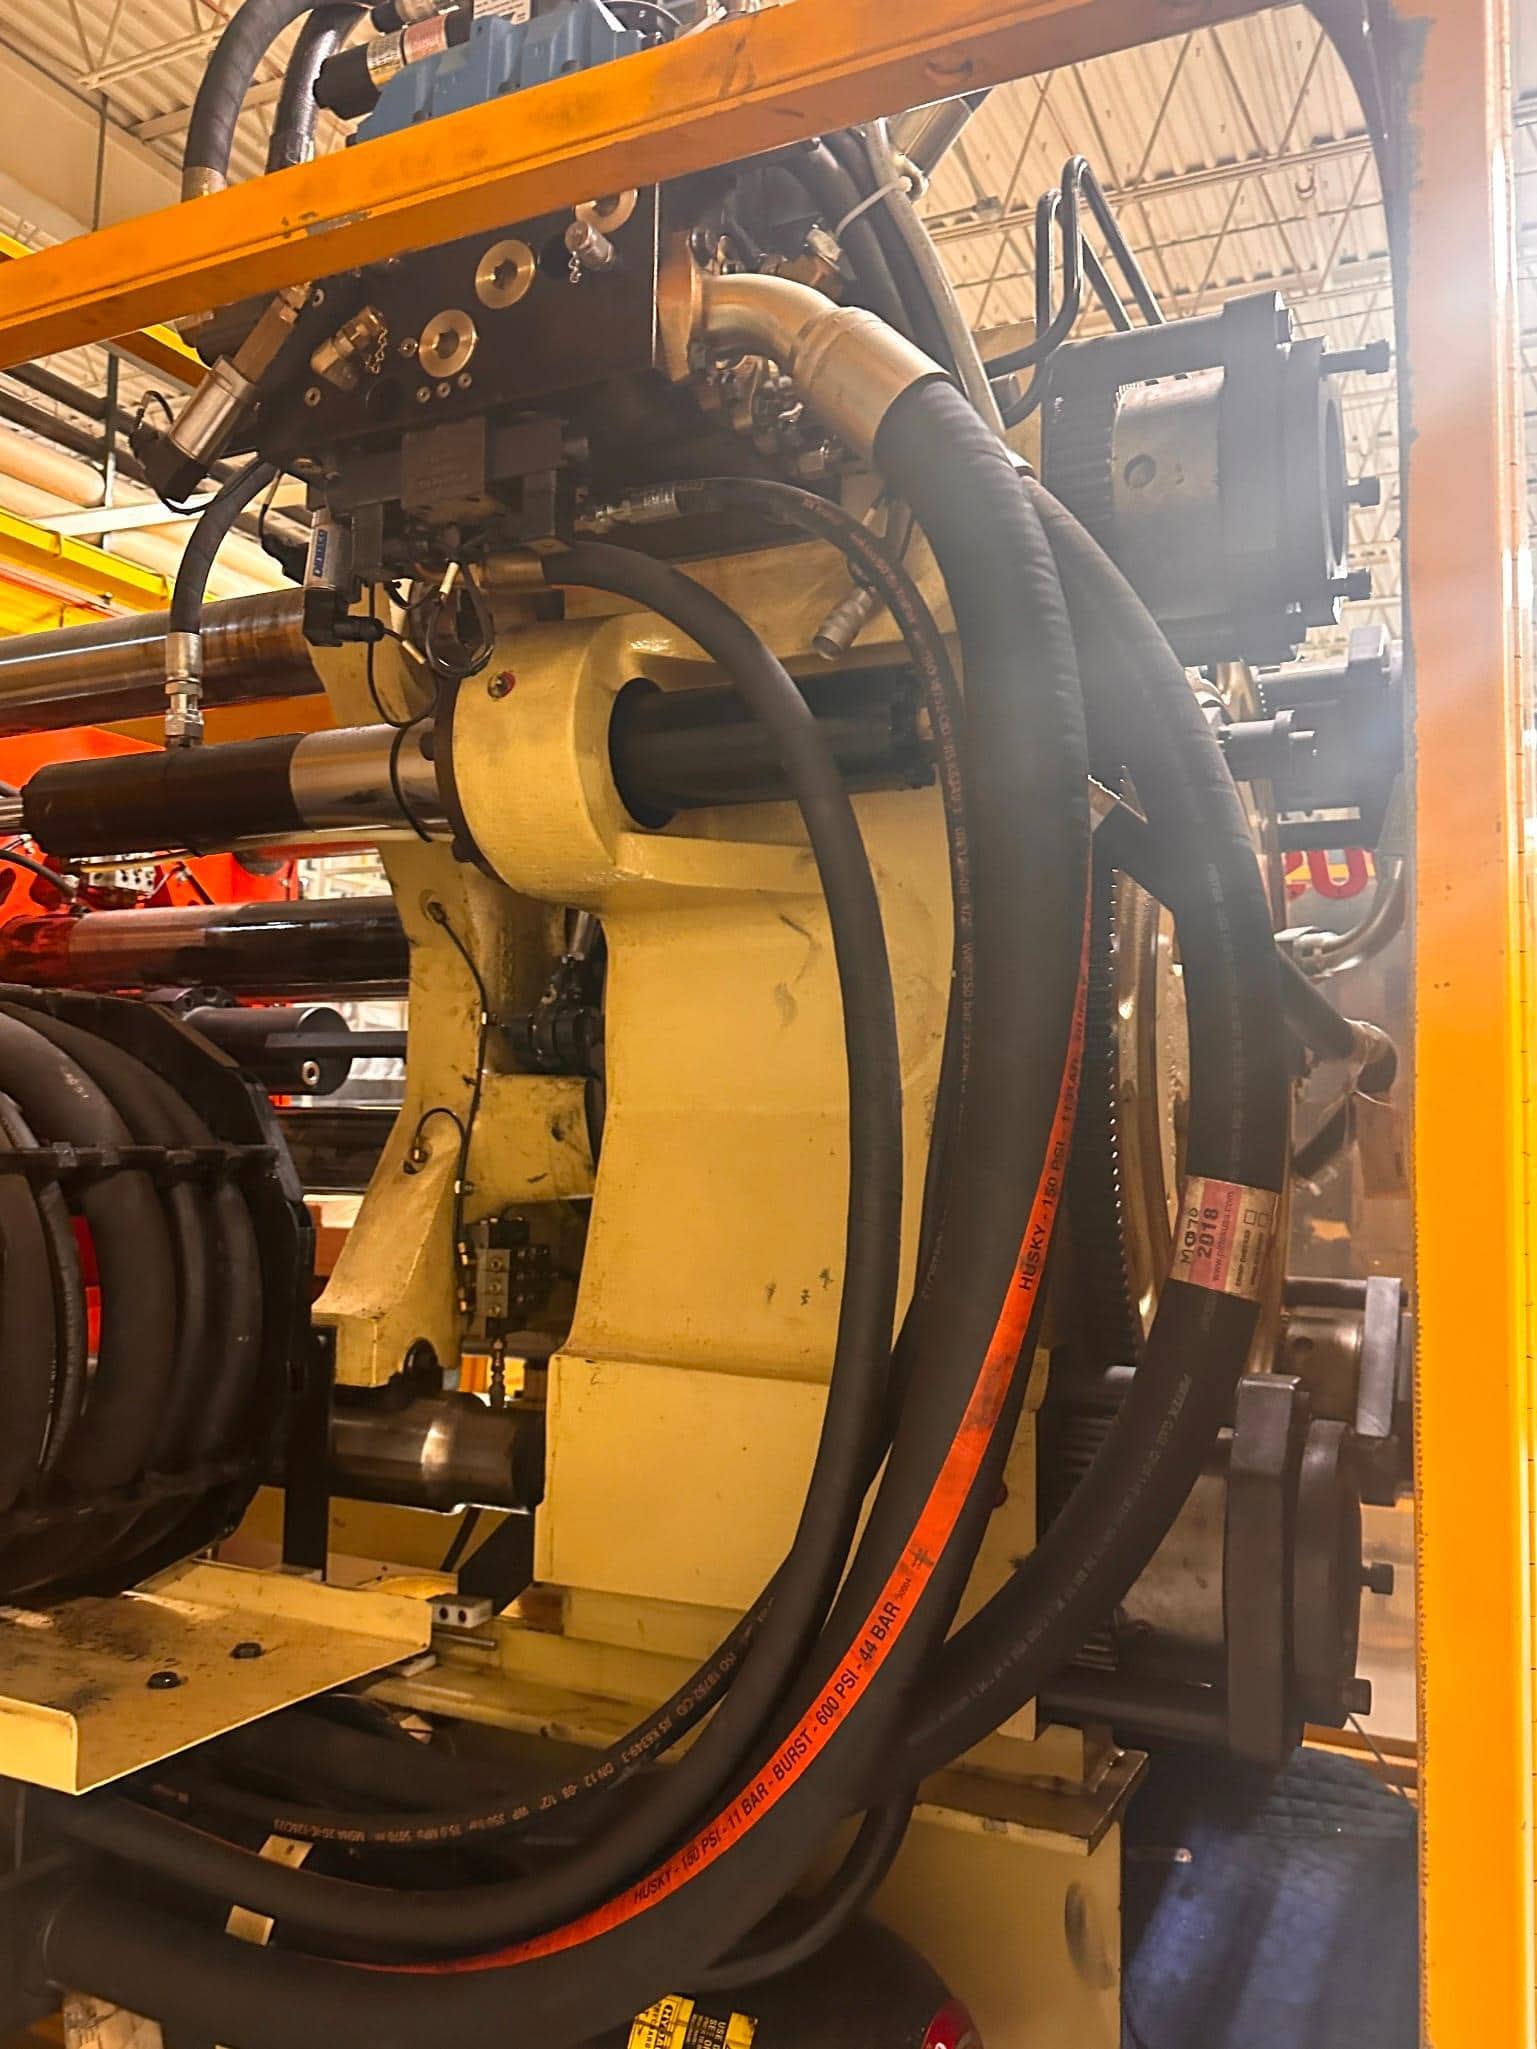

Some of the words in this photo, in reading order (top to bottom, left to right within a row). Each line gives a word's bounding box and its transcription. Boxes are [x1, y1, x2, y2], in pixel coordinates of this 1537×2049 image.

[1018, 1223, 1047, 1291] HUSKY
[1040, 1177, 1059, 1206] 150
[1051, 1140, 1065, 1172] PSI
[1197, 1207, 1219, 1259] 2018
[632, 1870, 674, 1904] HUSKY
[681, 1846, 702, 1873] 150
[701, 1827, 723, 1855] PSI
[727, 1811, 743, 1833] 11
[742, 1782, 769, 1817] BAR
[772, 1731, 816, 1782] BURST
[815, 1696, 841, 1727] 600
[833, 1670, 860, 1701] PSI
[858, 1639, 878, 1665] 44
[871, 1601, 901, 1641] BAR
